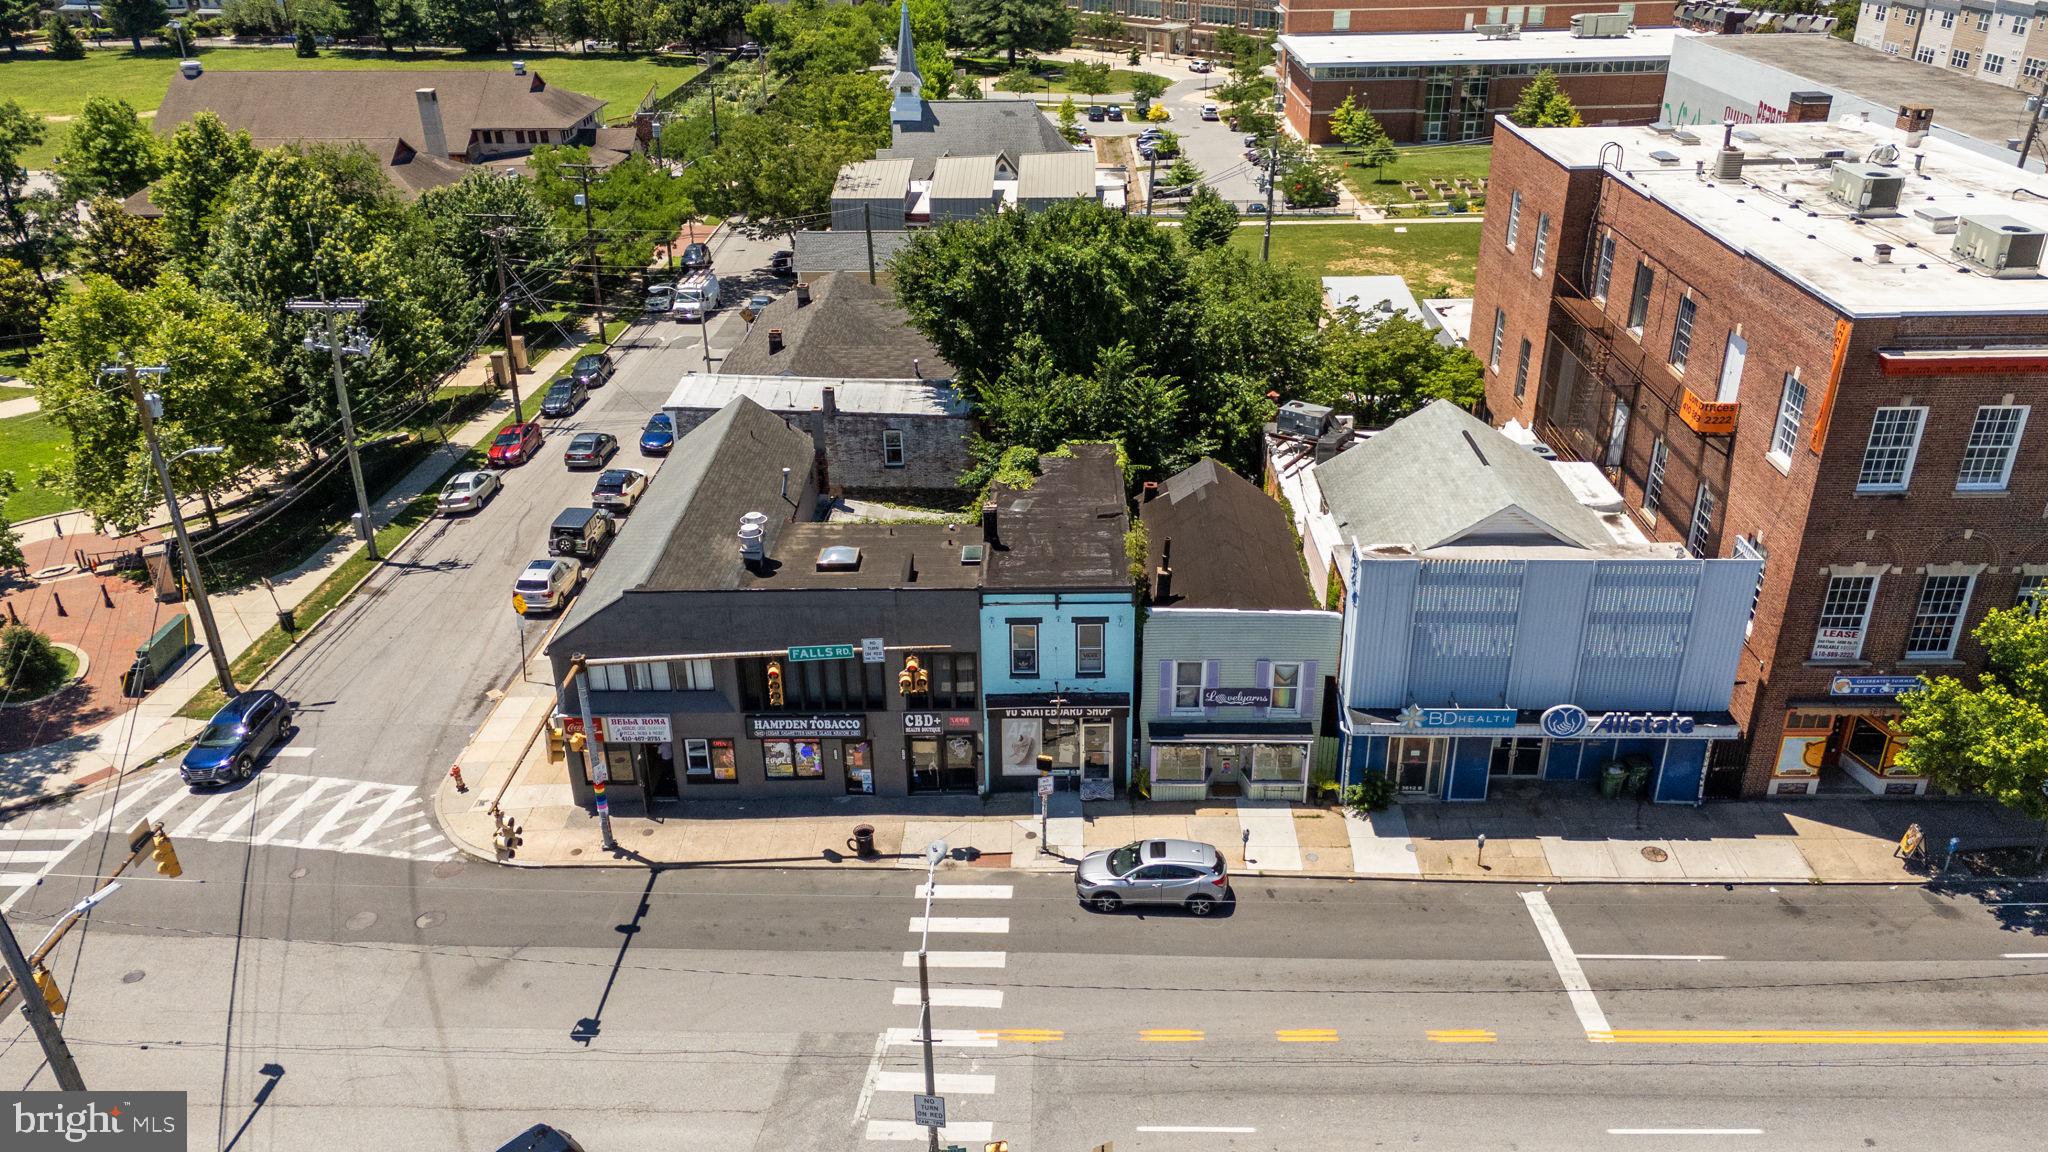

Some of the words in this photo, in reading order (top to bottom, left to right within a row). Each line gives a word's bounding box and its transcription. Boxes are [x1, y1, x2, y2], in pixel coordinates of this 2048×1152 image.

[1704, 416, 1732, 425] 2222
[1823, 629, 1859, 639] LEASE
[792, 647, 833, 659] FALLS
[836, 648, 852, 657] RD.
[1206, 690, 1268, 705] Lovelyarns
[905, 714, 941, 727] CBD+
[1429, 711, 1457, 725] BD
[1458, 715, 1510, 723] HEALTH
[1591, 712, 1695, 734] Allstate
[754, 720, 808, 729] HAMPDEN
[809, 720, 860, 729] TOBACCO
[920, 1104, 939, 1112] TURN
